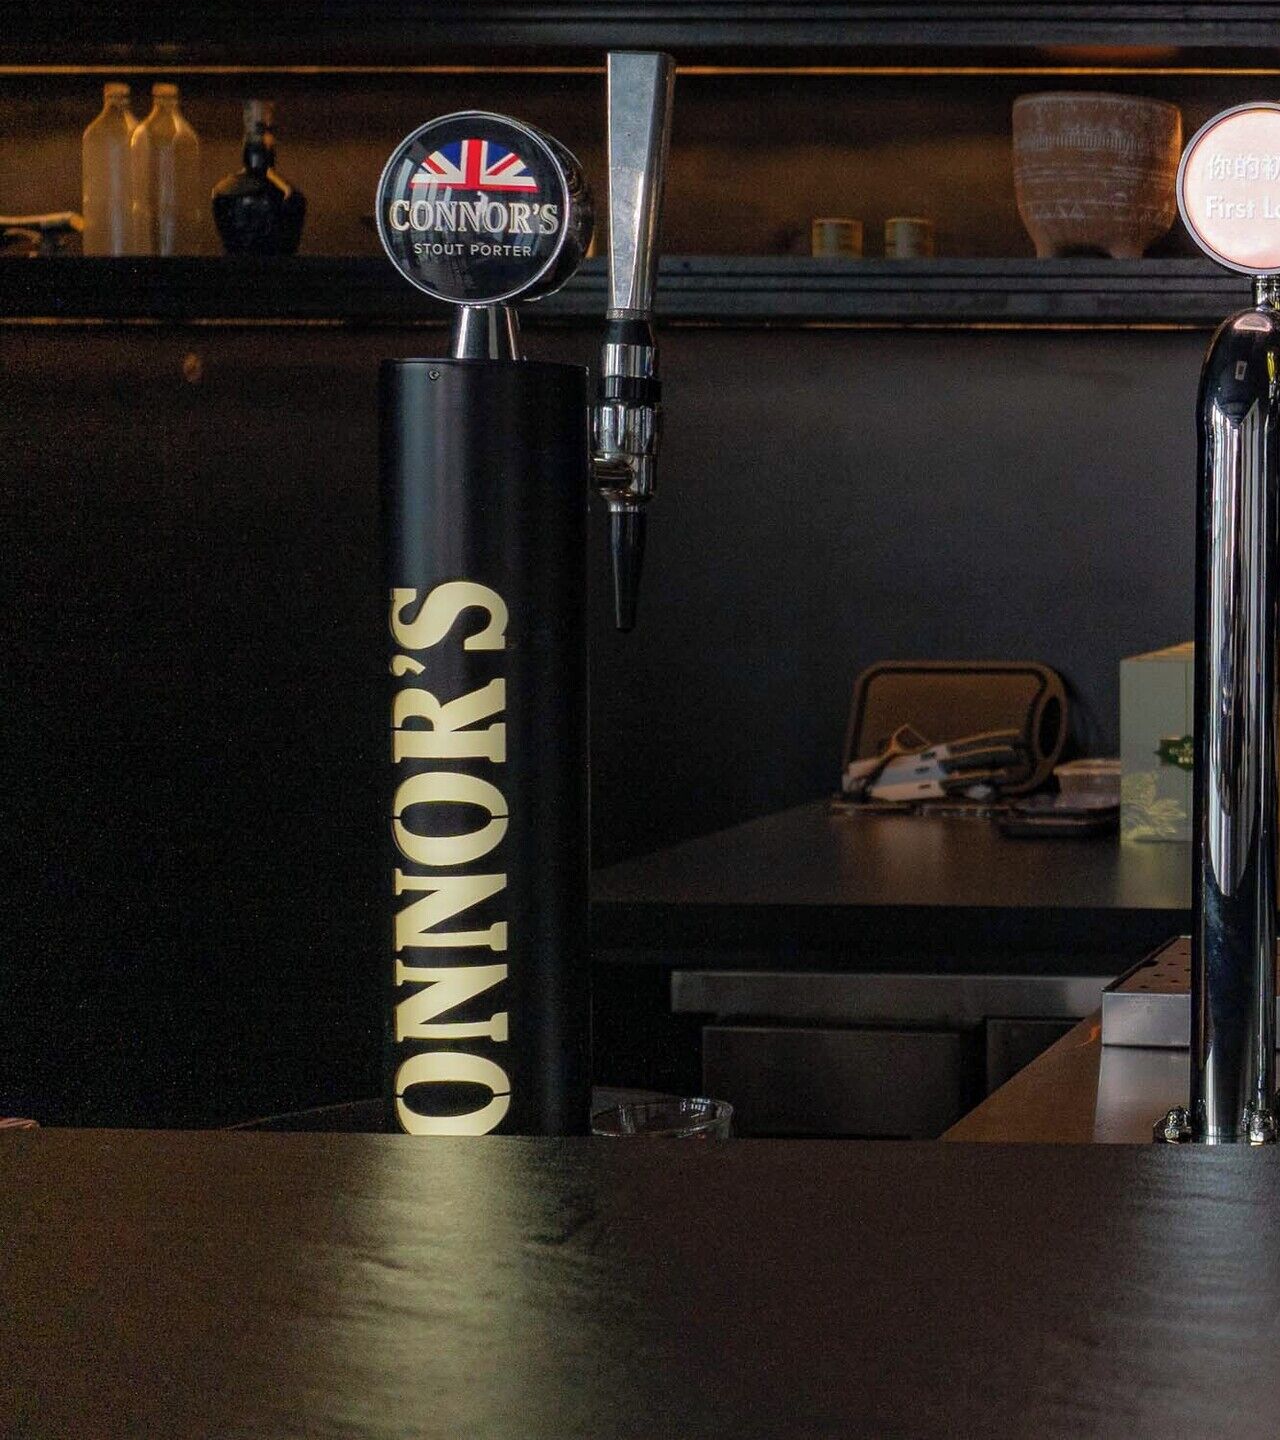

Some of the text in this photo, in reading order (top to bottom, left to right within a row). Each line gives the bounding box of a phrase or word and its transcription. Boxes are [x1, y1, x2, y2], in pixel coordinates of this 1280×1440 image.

[389, 199, 558, 235] CONNOR'S
[1205, 195, 1256, 220] First
[413, 242, 532, 258] STOUT PORTER
